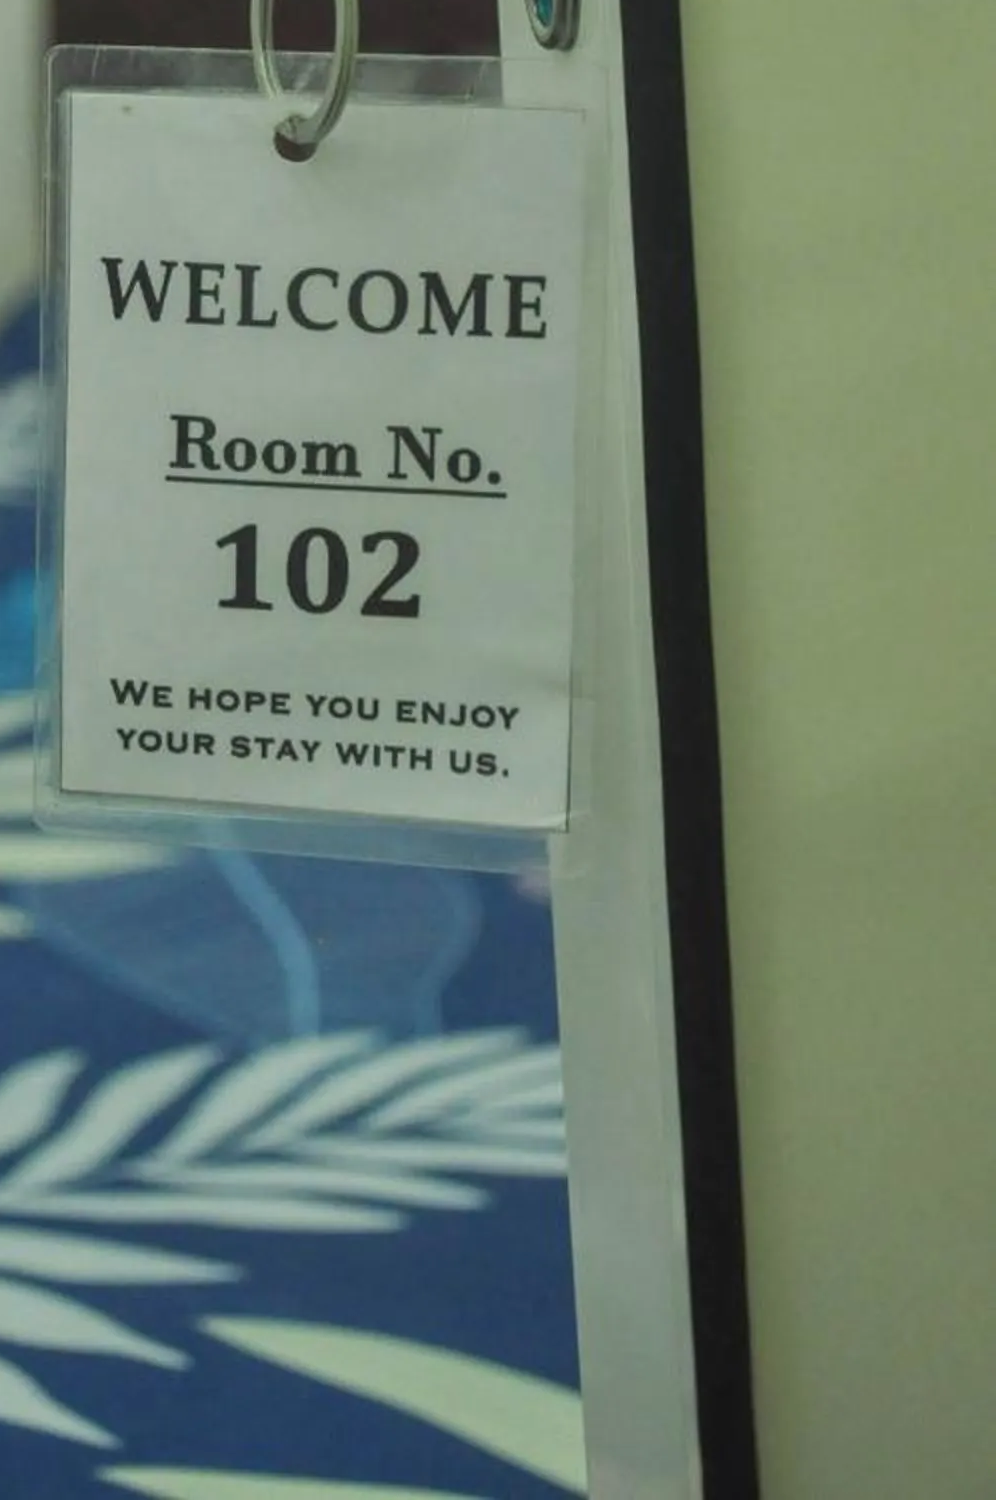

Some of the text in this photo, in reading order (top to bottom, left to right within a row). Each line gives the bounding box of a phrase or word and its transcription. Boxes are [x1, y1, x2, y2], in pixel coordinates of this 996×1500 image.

[100, 256, 548, 340] WELCOME
[168, 413, 503, 486] Room No.
[215, 522, 422, 619] 102
[109, 677, 520, 731] WE HOPE YOU ENJOY
[115, 727, 510, 779] YOUR STAY WITH US.
